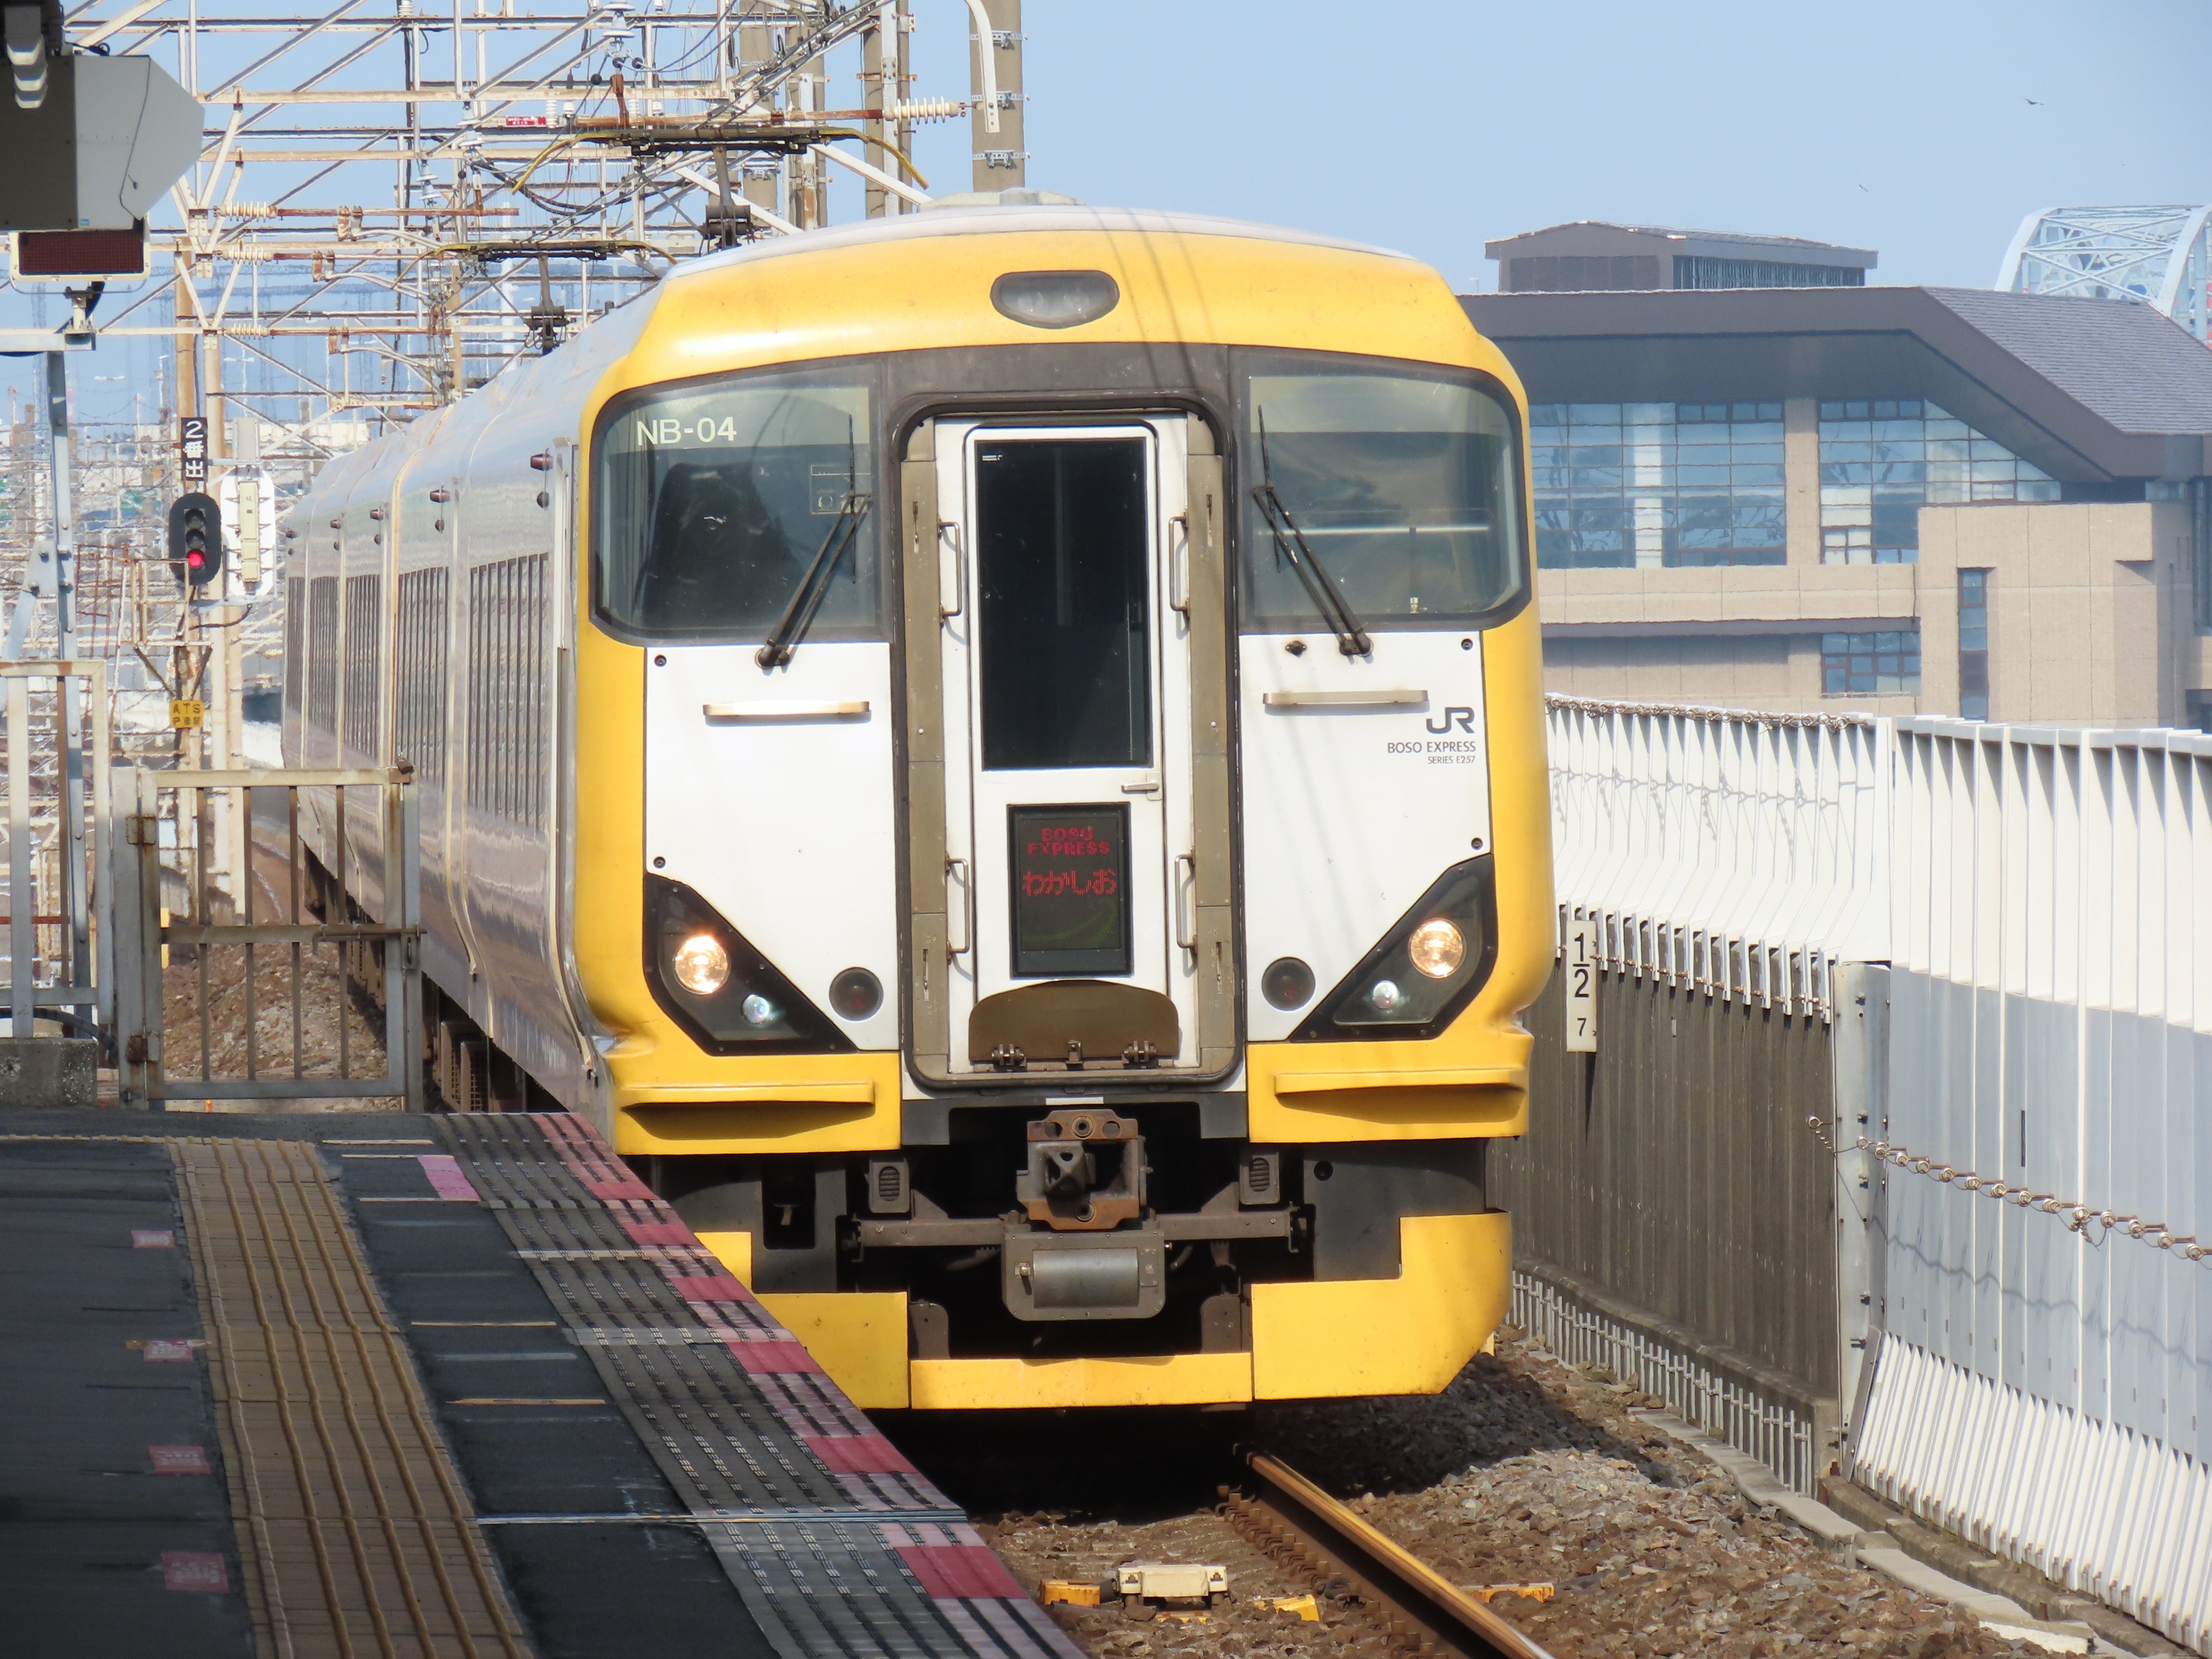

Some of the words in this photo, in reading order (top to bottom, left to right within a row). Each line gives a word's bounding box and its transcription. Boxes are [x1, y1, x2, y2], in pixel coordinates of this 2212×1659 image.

[173, 254, 200, 264] ATS
[637, 416, 737, 446] NB-04
[1426, 707, 1475, 734] JR
[1388, 742, 1422, 753] BOSO
[1427, 741, 1476, 752] EXPRESS
[1428, 756, 1453, 764] SERIES
[1456, 755, 1476, 764] E257
[1027, 841, 1110, 855] EXPRESS
[1022, 870, 1116, 896] わかしお
[1577, 1018, 1587, 1036] 7
